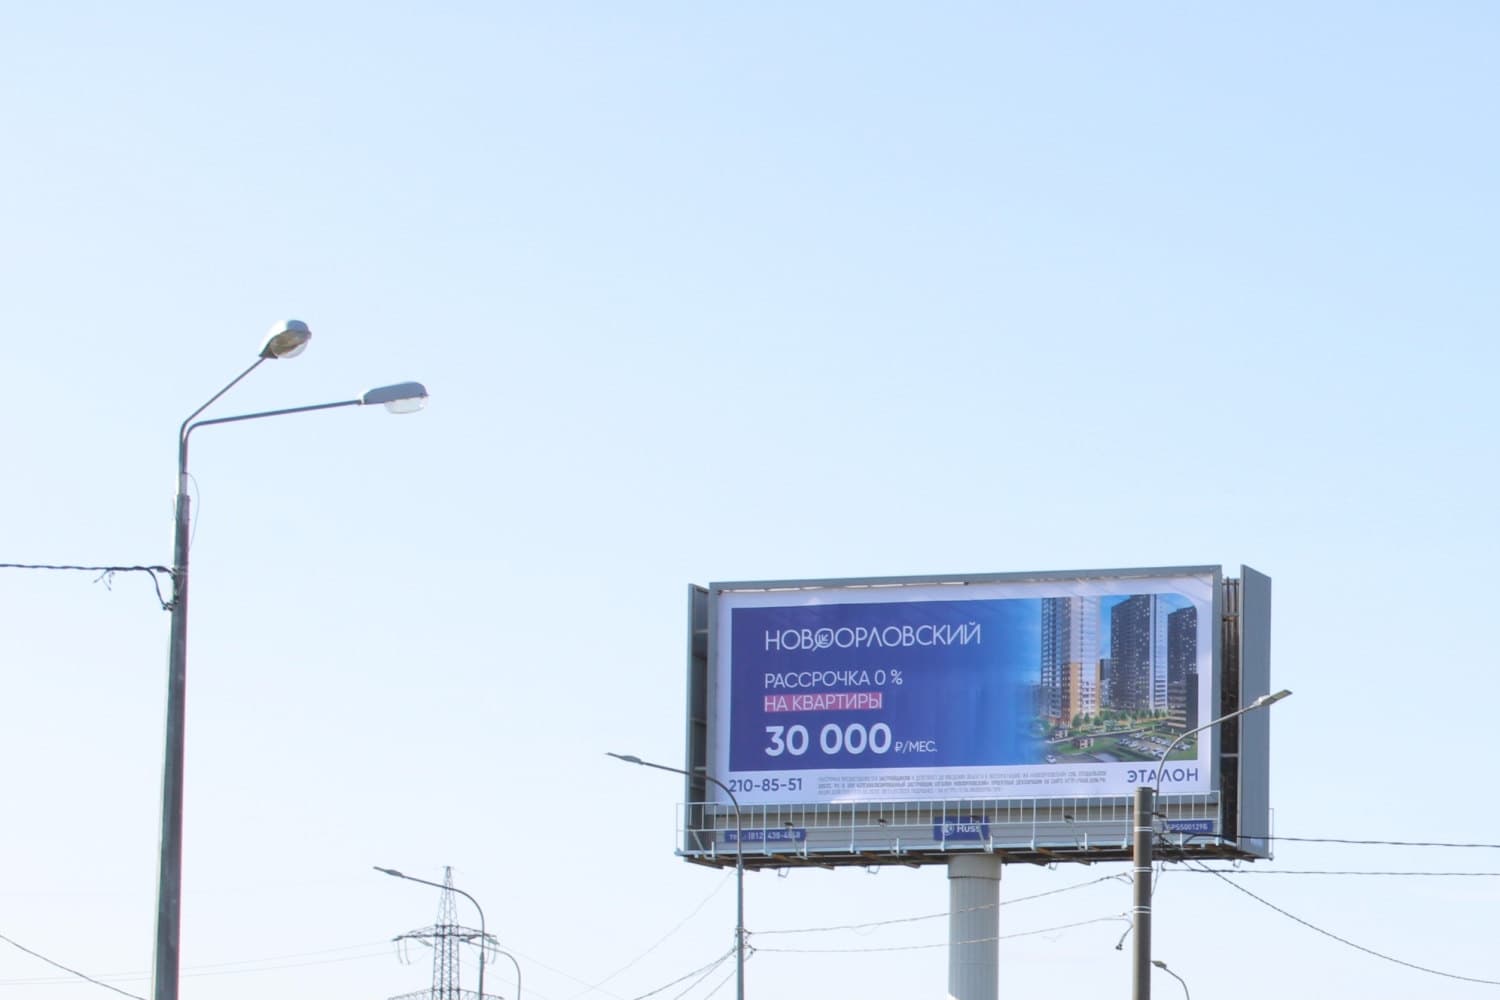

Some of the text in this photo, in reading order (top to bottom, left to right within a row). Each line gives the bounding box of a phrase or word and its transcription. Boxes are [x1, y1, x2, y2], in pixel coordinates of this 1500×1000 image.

[764, 621, 982, 652] НОВООРЛОВСКИЙ
[764, 668, 904, 689] РАССРОЧКА 0 %
[764, 692, 882, 712] НА КВАРТИРЫ
[764, 724, 810, 757] 30
[819, 722, 893, 755] 000
[729, 777, 802, 793] 210-85-51
[1127, 768, 1198, 783] ЭТАЛОН
